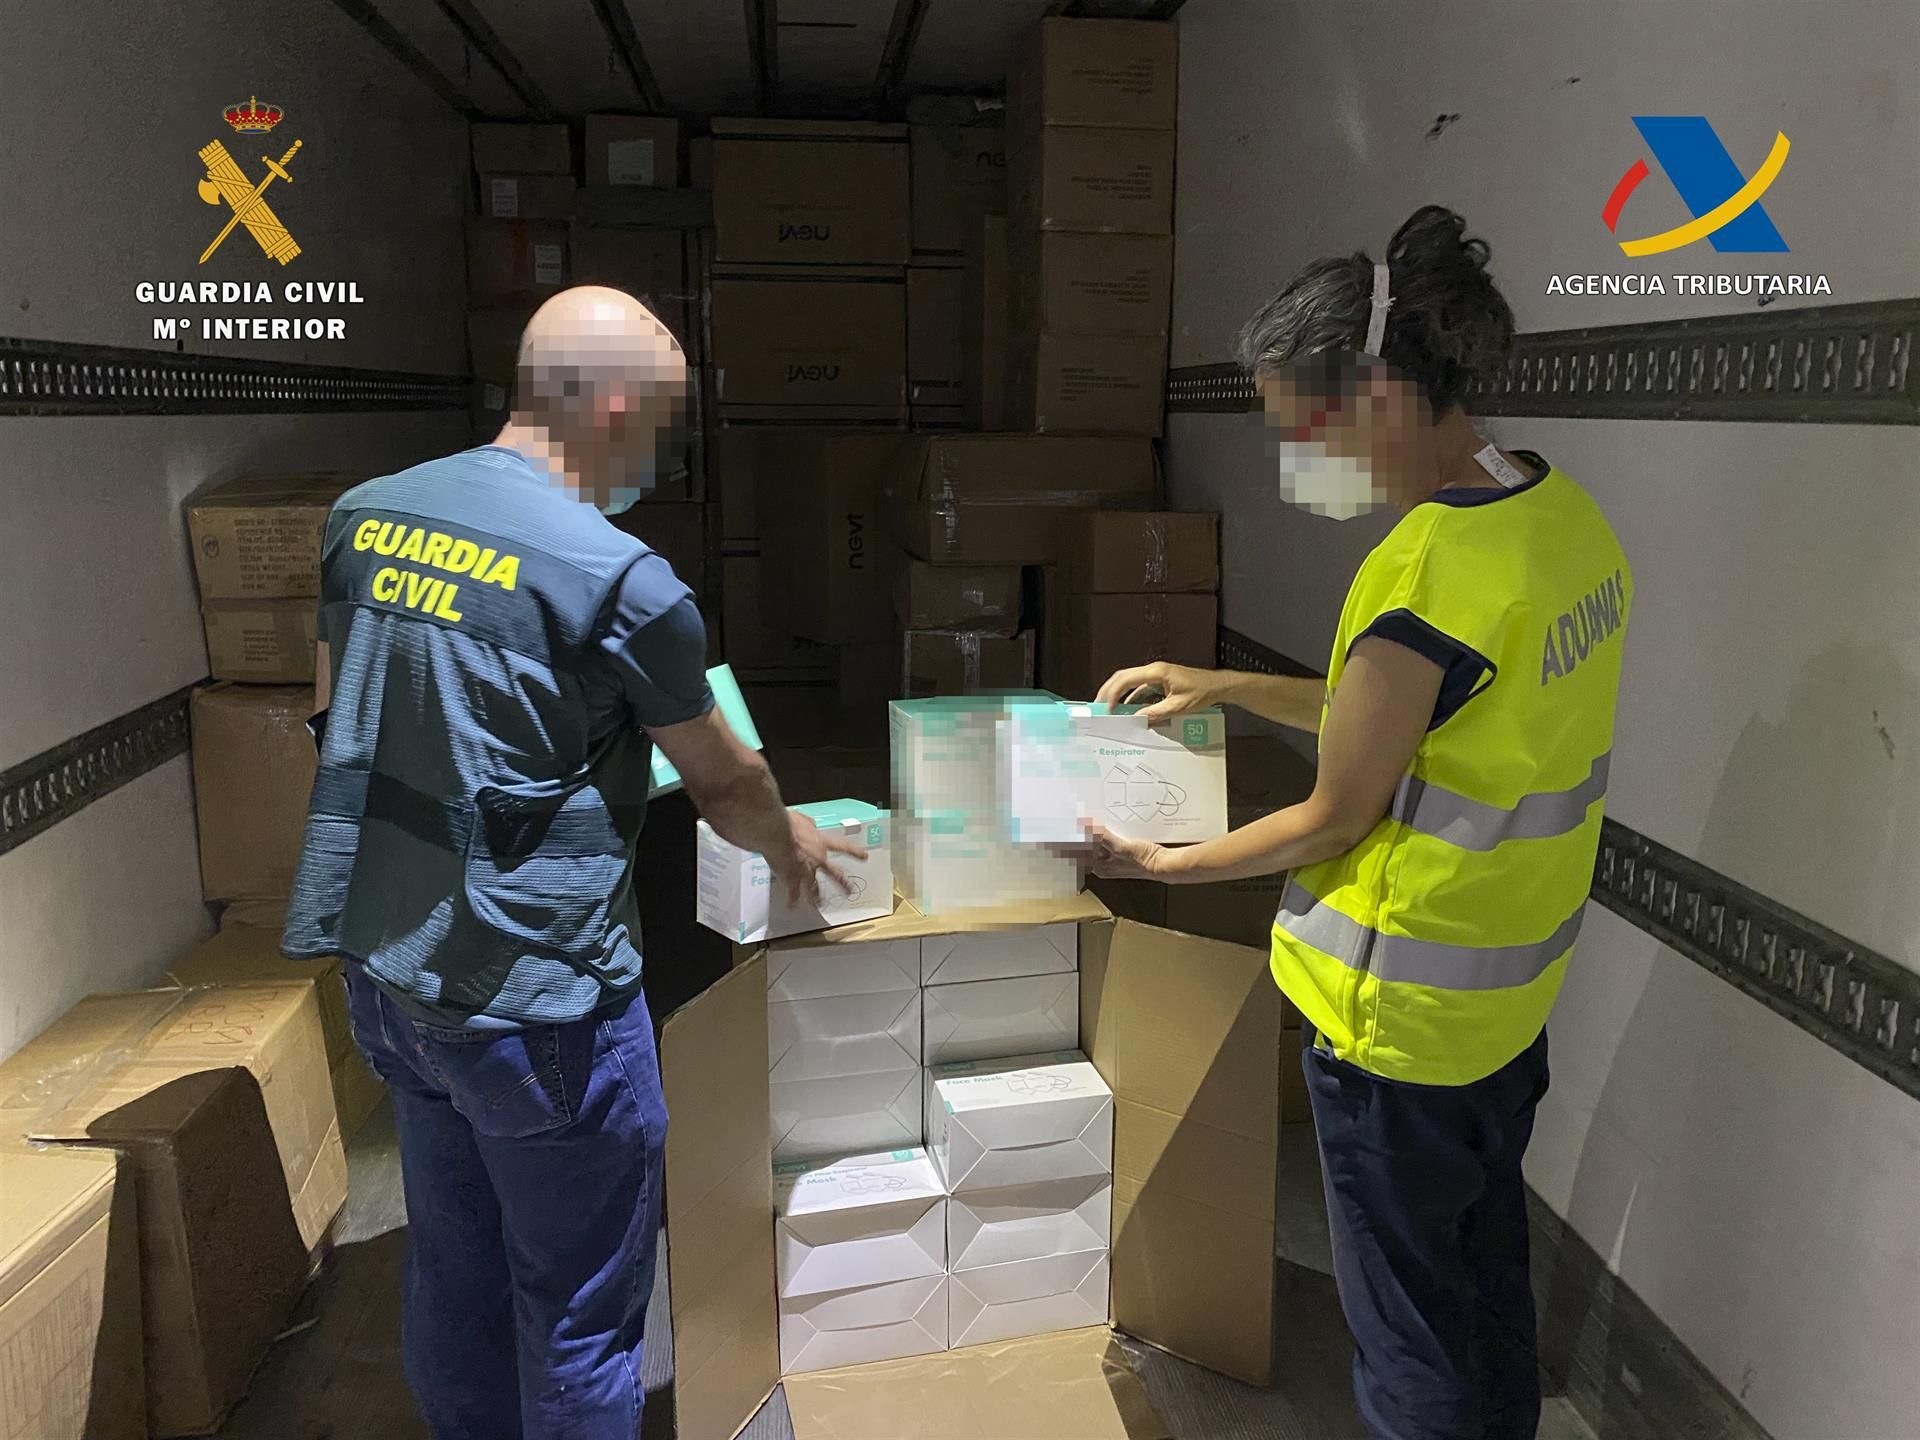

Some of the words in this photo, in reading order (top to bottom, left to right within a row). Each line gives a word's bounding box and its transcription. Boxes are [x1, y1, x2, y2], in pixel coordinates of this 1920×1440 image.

[976, 151, 1006, 168] ne
[353, 519, 520, 591] GUARDIA
[371, 567, 463, 623] CIVIL
[1541, 568, 1624, 687] ADUANAS
[1186, 723, 1205, 736] 50
[1099, 747, 1147, 758] Respirator
[974, 1074, 1003, 1084] Mask
[806, 1175, 836, 1185] Mask
